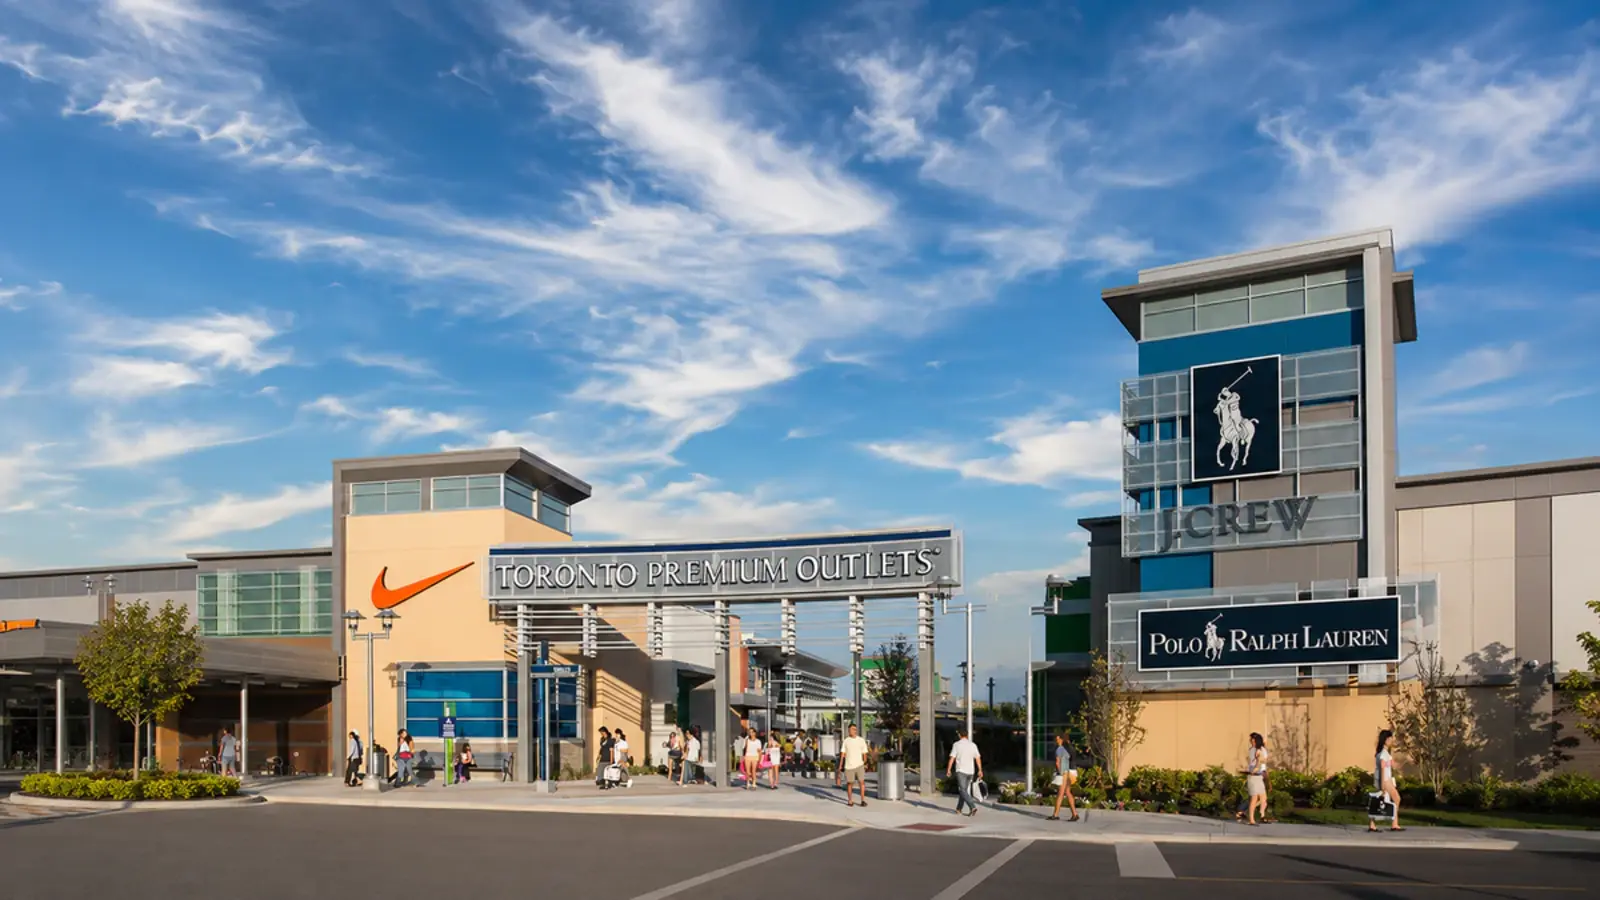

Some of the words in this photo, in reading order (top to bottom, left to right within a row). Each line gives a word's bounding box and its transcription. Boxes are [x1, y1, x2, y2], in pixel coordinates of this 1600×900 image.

[1157, 495, 1318, 552] J.CREW
[495, 562, 638, 589] TORONTO
[646, 556, 788, 587] PREMIUM
[1149, 632, 1203, 656] POLO
[1229, 628, 1298, 652] RALPH
[1302, 625, 1389, 649] LAUREN
